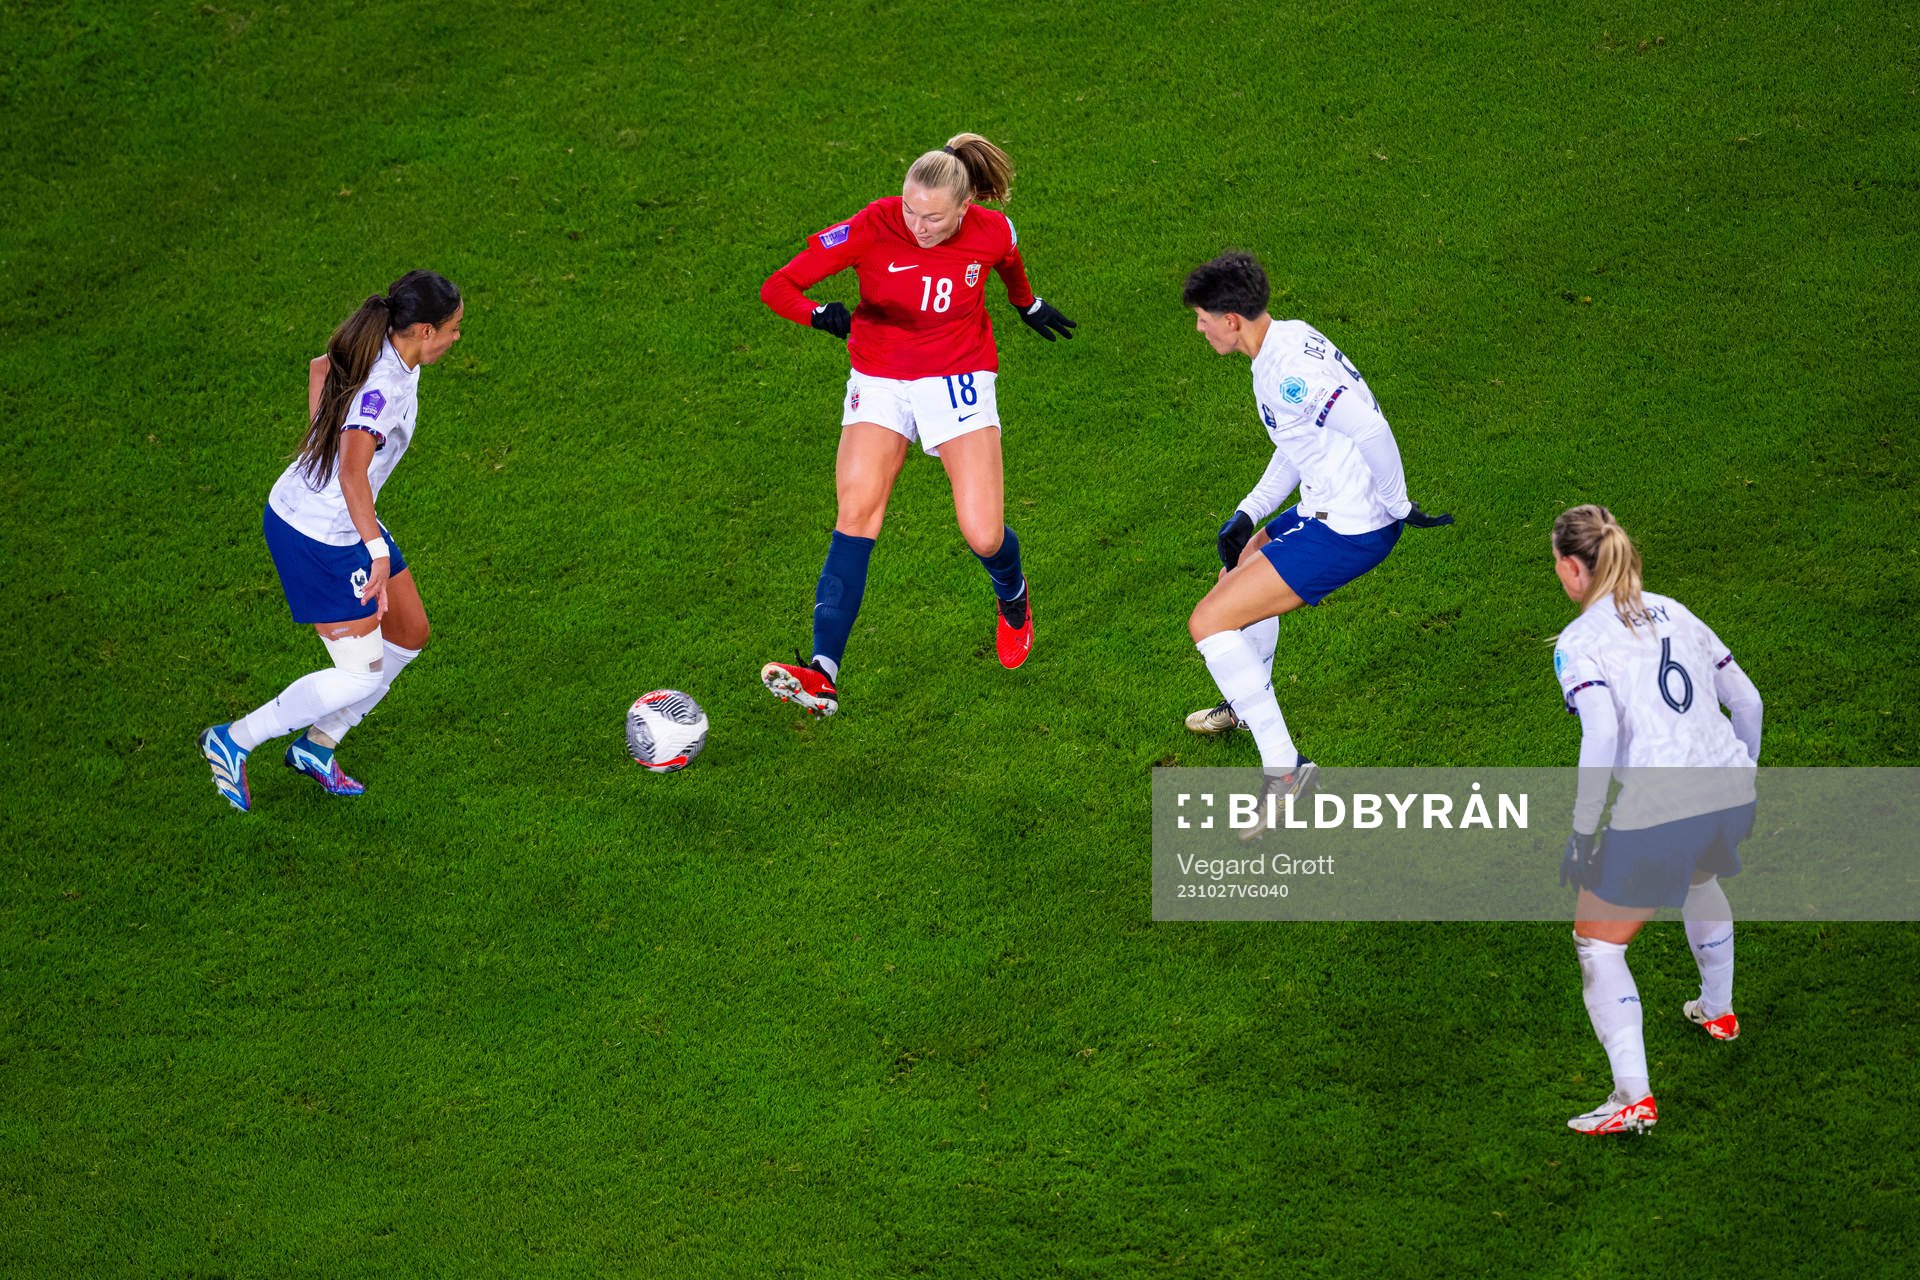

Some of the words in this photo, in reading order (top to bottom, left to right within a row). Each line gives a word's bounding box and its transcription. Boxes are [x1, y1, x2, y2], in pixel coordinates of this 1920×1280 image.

[920, 276, 953, 313] 18
[942, 372, 978, 409] 18
[1658, 637, 1693, 714] 6
